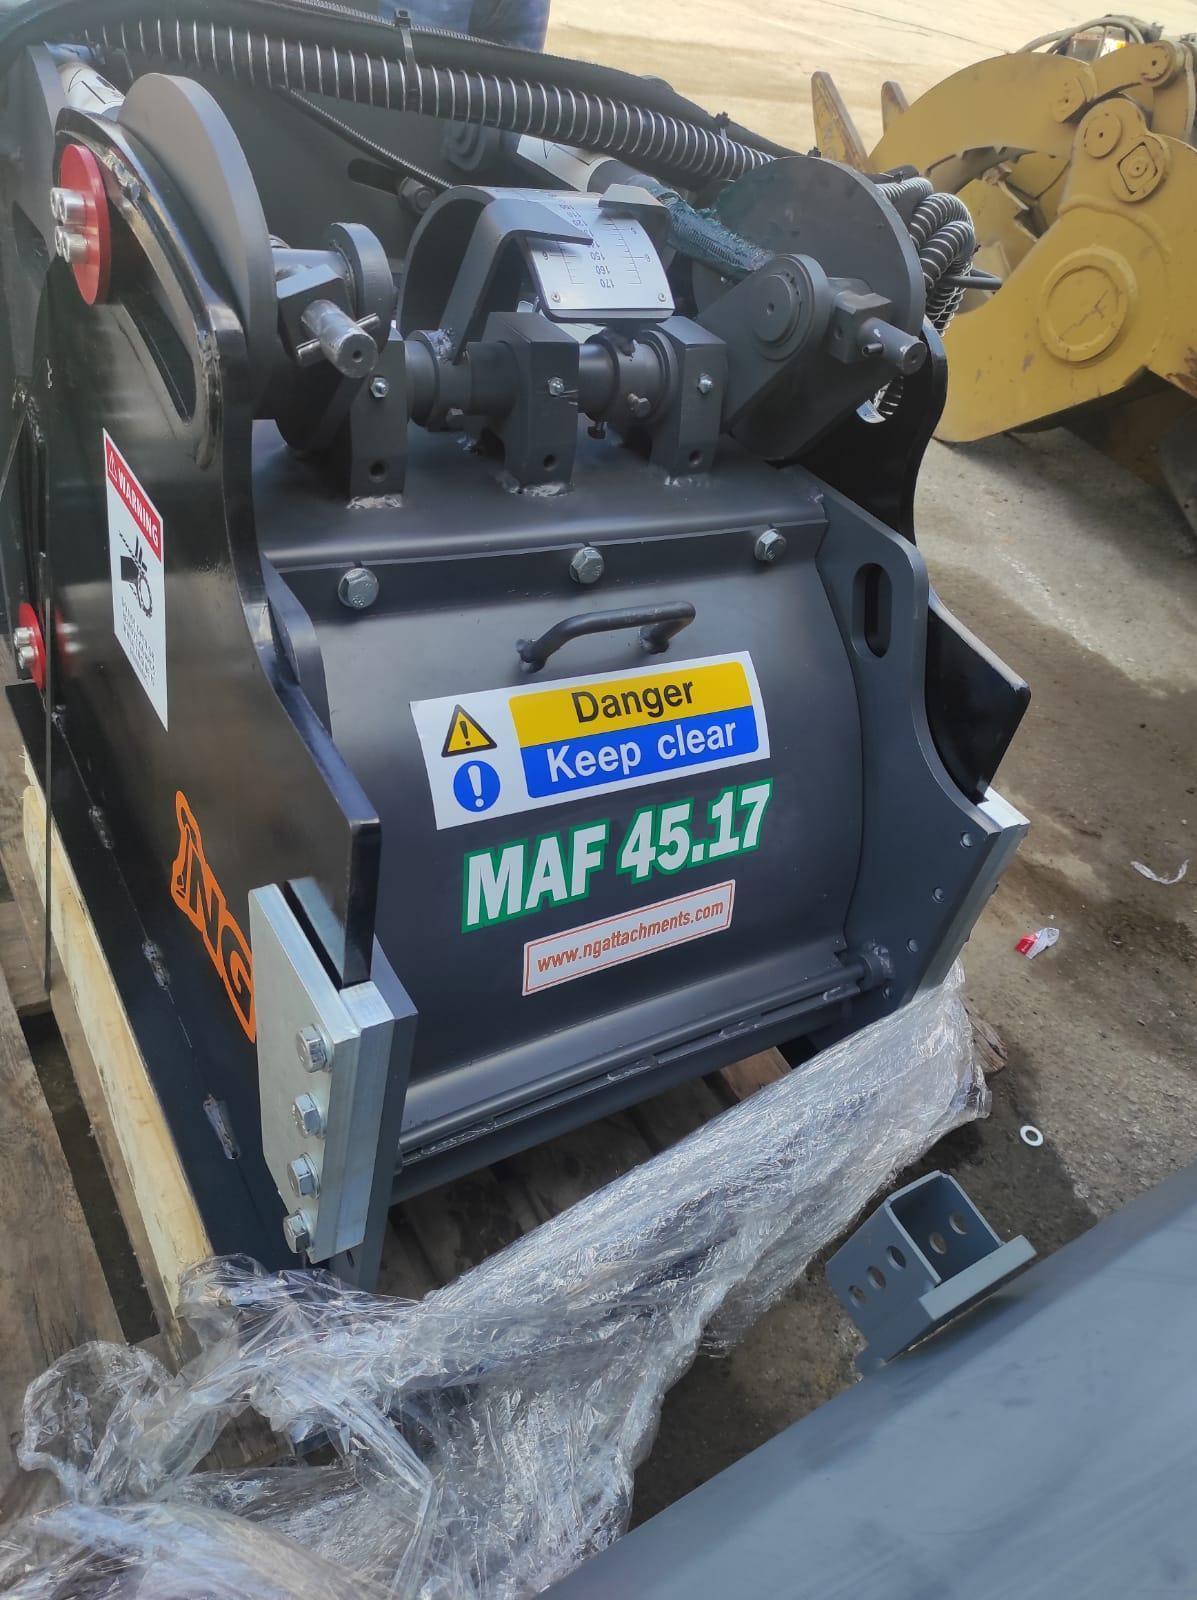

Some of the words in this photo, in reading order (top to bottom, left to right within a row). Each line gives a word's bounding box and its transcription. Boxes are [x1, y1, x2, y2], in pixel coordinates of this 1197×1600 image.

[542, 250, 549, 261] 6
[590, 251, 605, 261] 150
[595, 265, 610, 275] 160
[599, 278, 615, 289] 170
[118, 468, 159, 548] WARNING
[571, 680, 694, 723] Danger
[547, 740, 642, 783] Keep
[657, 720, 737, 760] clear
[464, 820, 608, 930] MAF
[618, 779, 772, 882] 45.17
[537, 900, 724, 973] www.ngattachments.com
